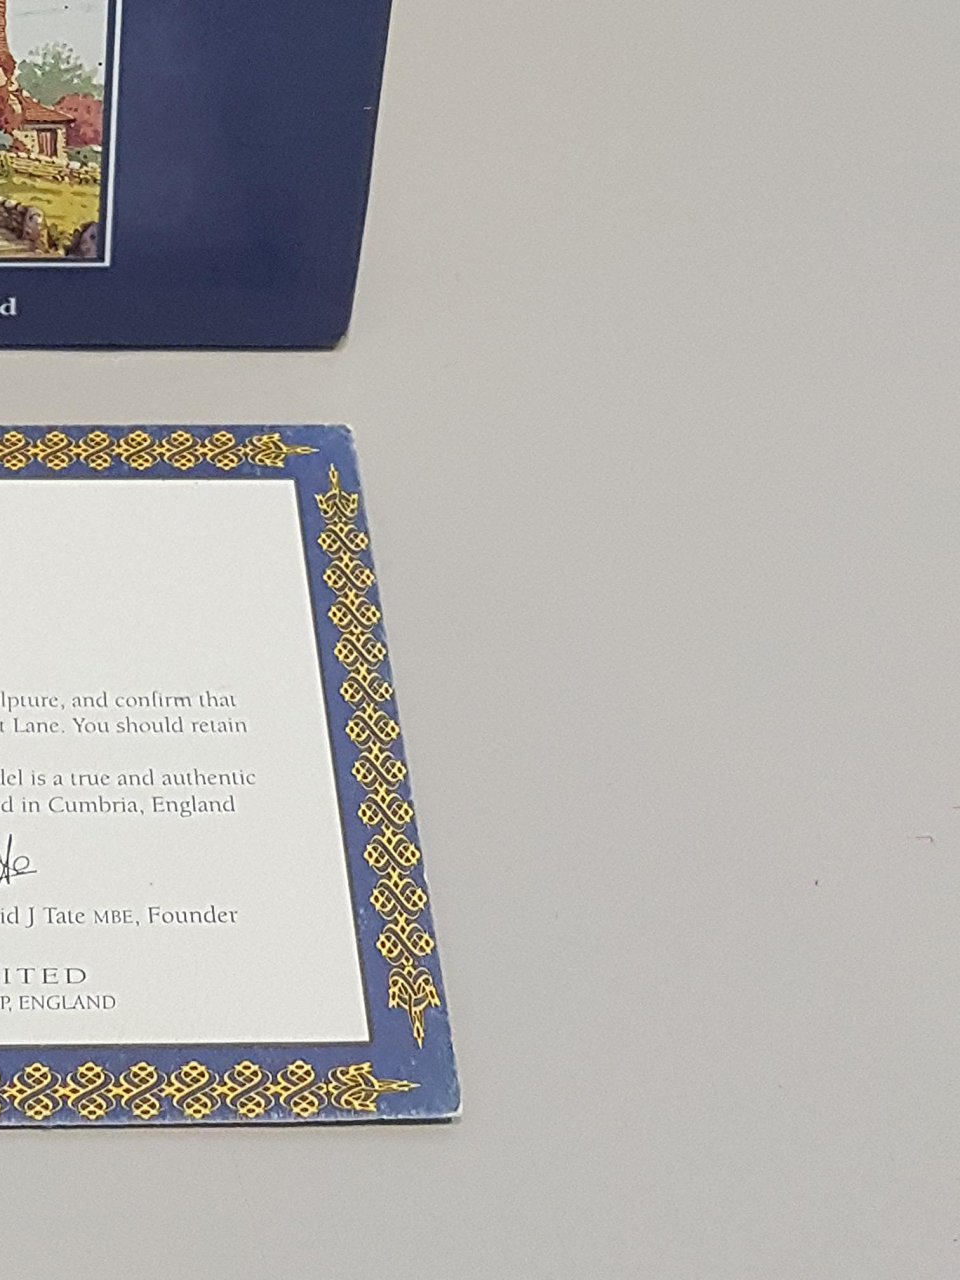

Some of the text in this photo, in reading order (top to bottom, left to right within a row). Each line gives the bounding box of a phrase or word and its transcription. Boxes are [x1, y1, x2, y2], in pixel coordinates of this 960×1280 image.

[71, 691, 108, 709] and
[114, 690, 192, 709] confirm
[198, 690, 237, 709] that
[13, 717, 66, 734] Lane.
[72, 717, 110, 734] You
[115, 716, 185, 734] should
[190, 717, 248, 734] retain
[30, 768, 47, 787] is
[70, 770, 112, 787] true
[116, 768, 154, 787] and
[161, 768, 257, 787] authentic
[21, 795, 41, 813] in
[47, 795, 145, 815] Cumbria,
[151, 795, 236, 818] England
[43, 906, 86, 925] Tate
[93, 907, 141, 927] MBE,
[147, 905, 238, 925] Founder
[18, 994, 117, 1011] ENGLAND
